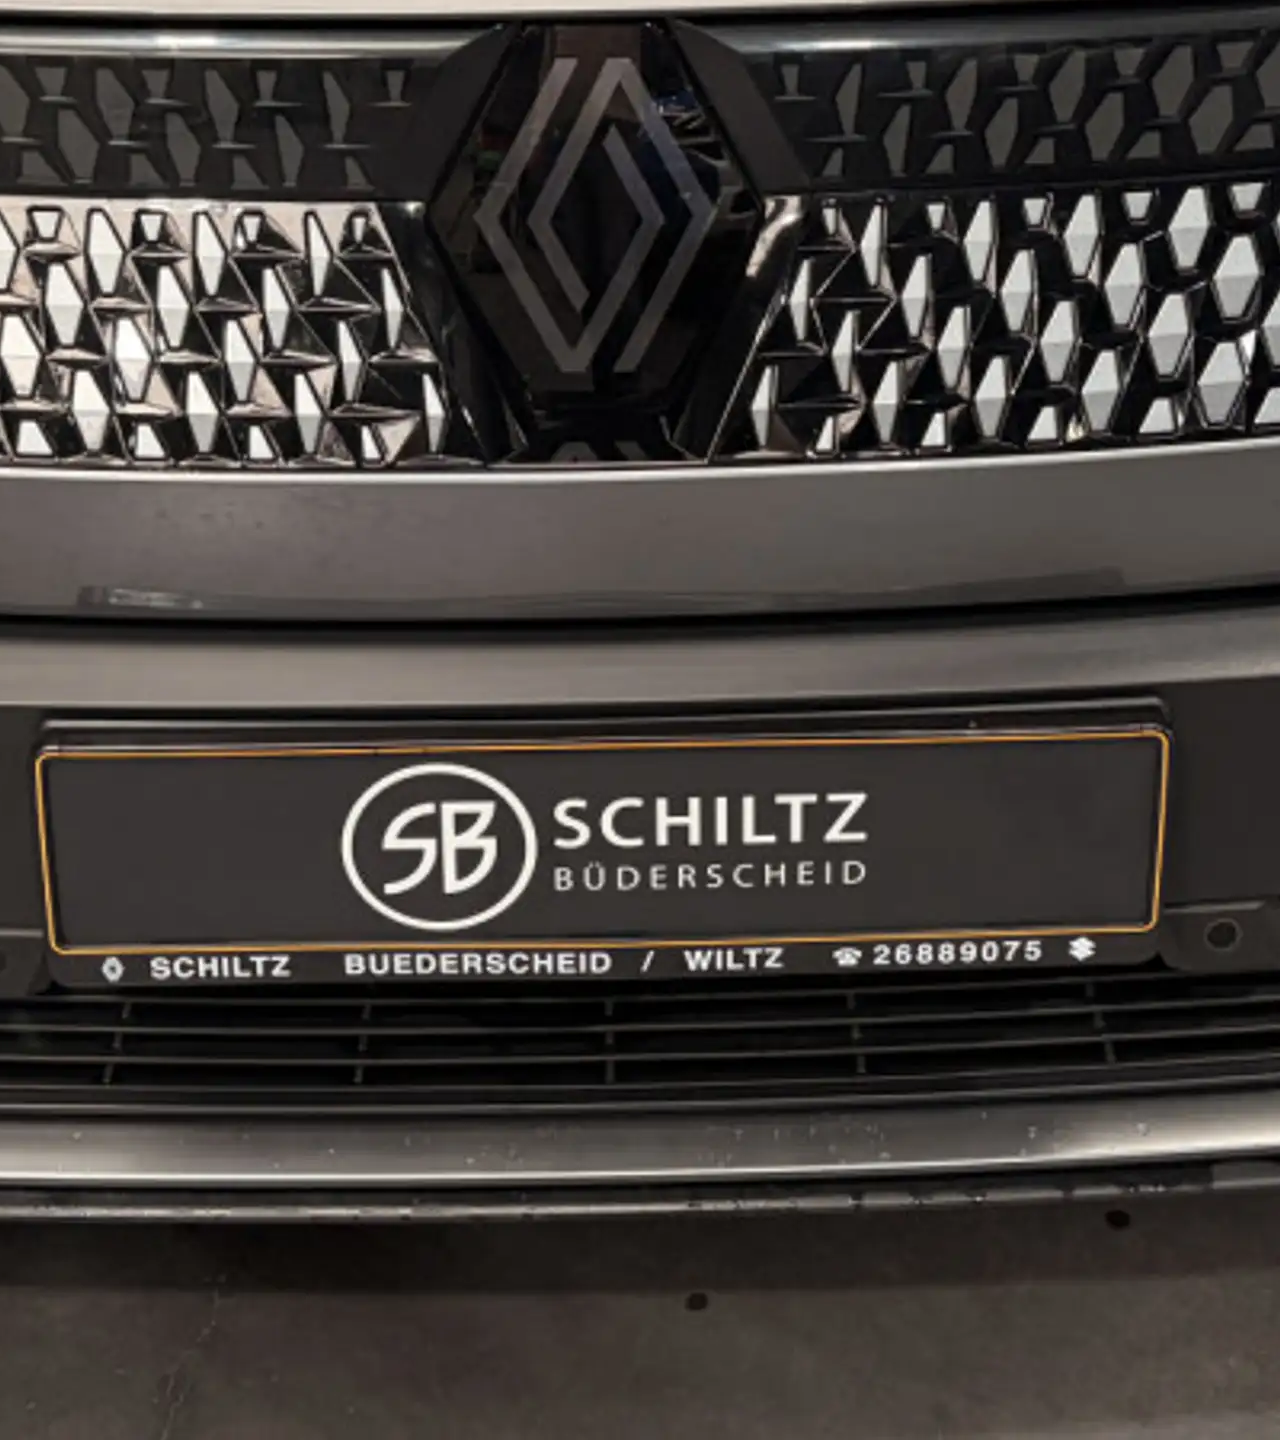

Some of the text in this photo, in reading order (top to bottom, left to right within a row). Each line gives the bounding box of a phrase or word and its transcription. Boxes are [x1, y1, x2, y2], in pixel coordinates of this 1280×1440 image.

[552, 791, 869, 850] SCHILTZ
[381, 800, 498, 895] SB
[553, 860, 868, 892] BÜDERSCHEID
[149, 955, 292, 980] SCHILTZ
[343, 951, 613, 976] BUEDERSCHEID
[683, 946, 785, 972] WILTZ
[873, 939, 1043, 966] 26889075
